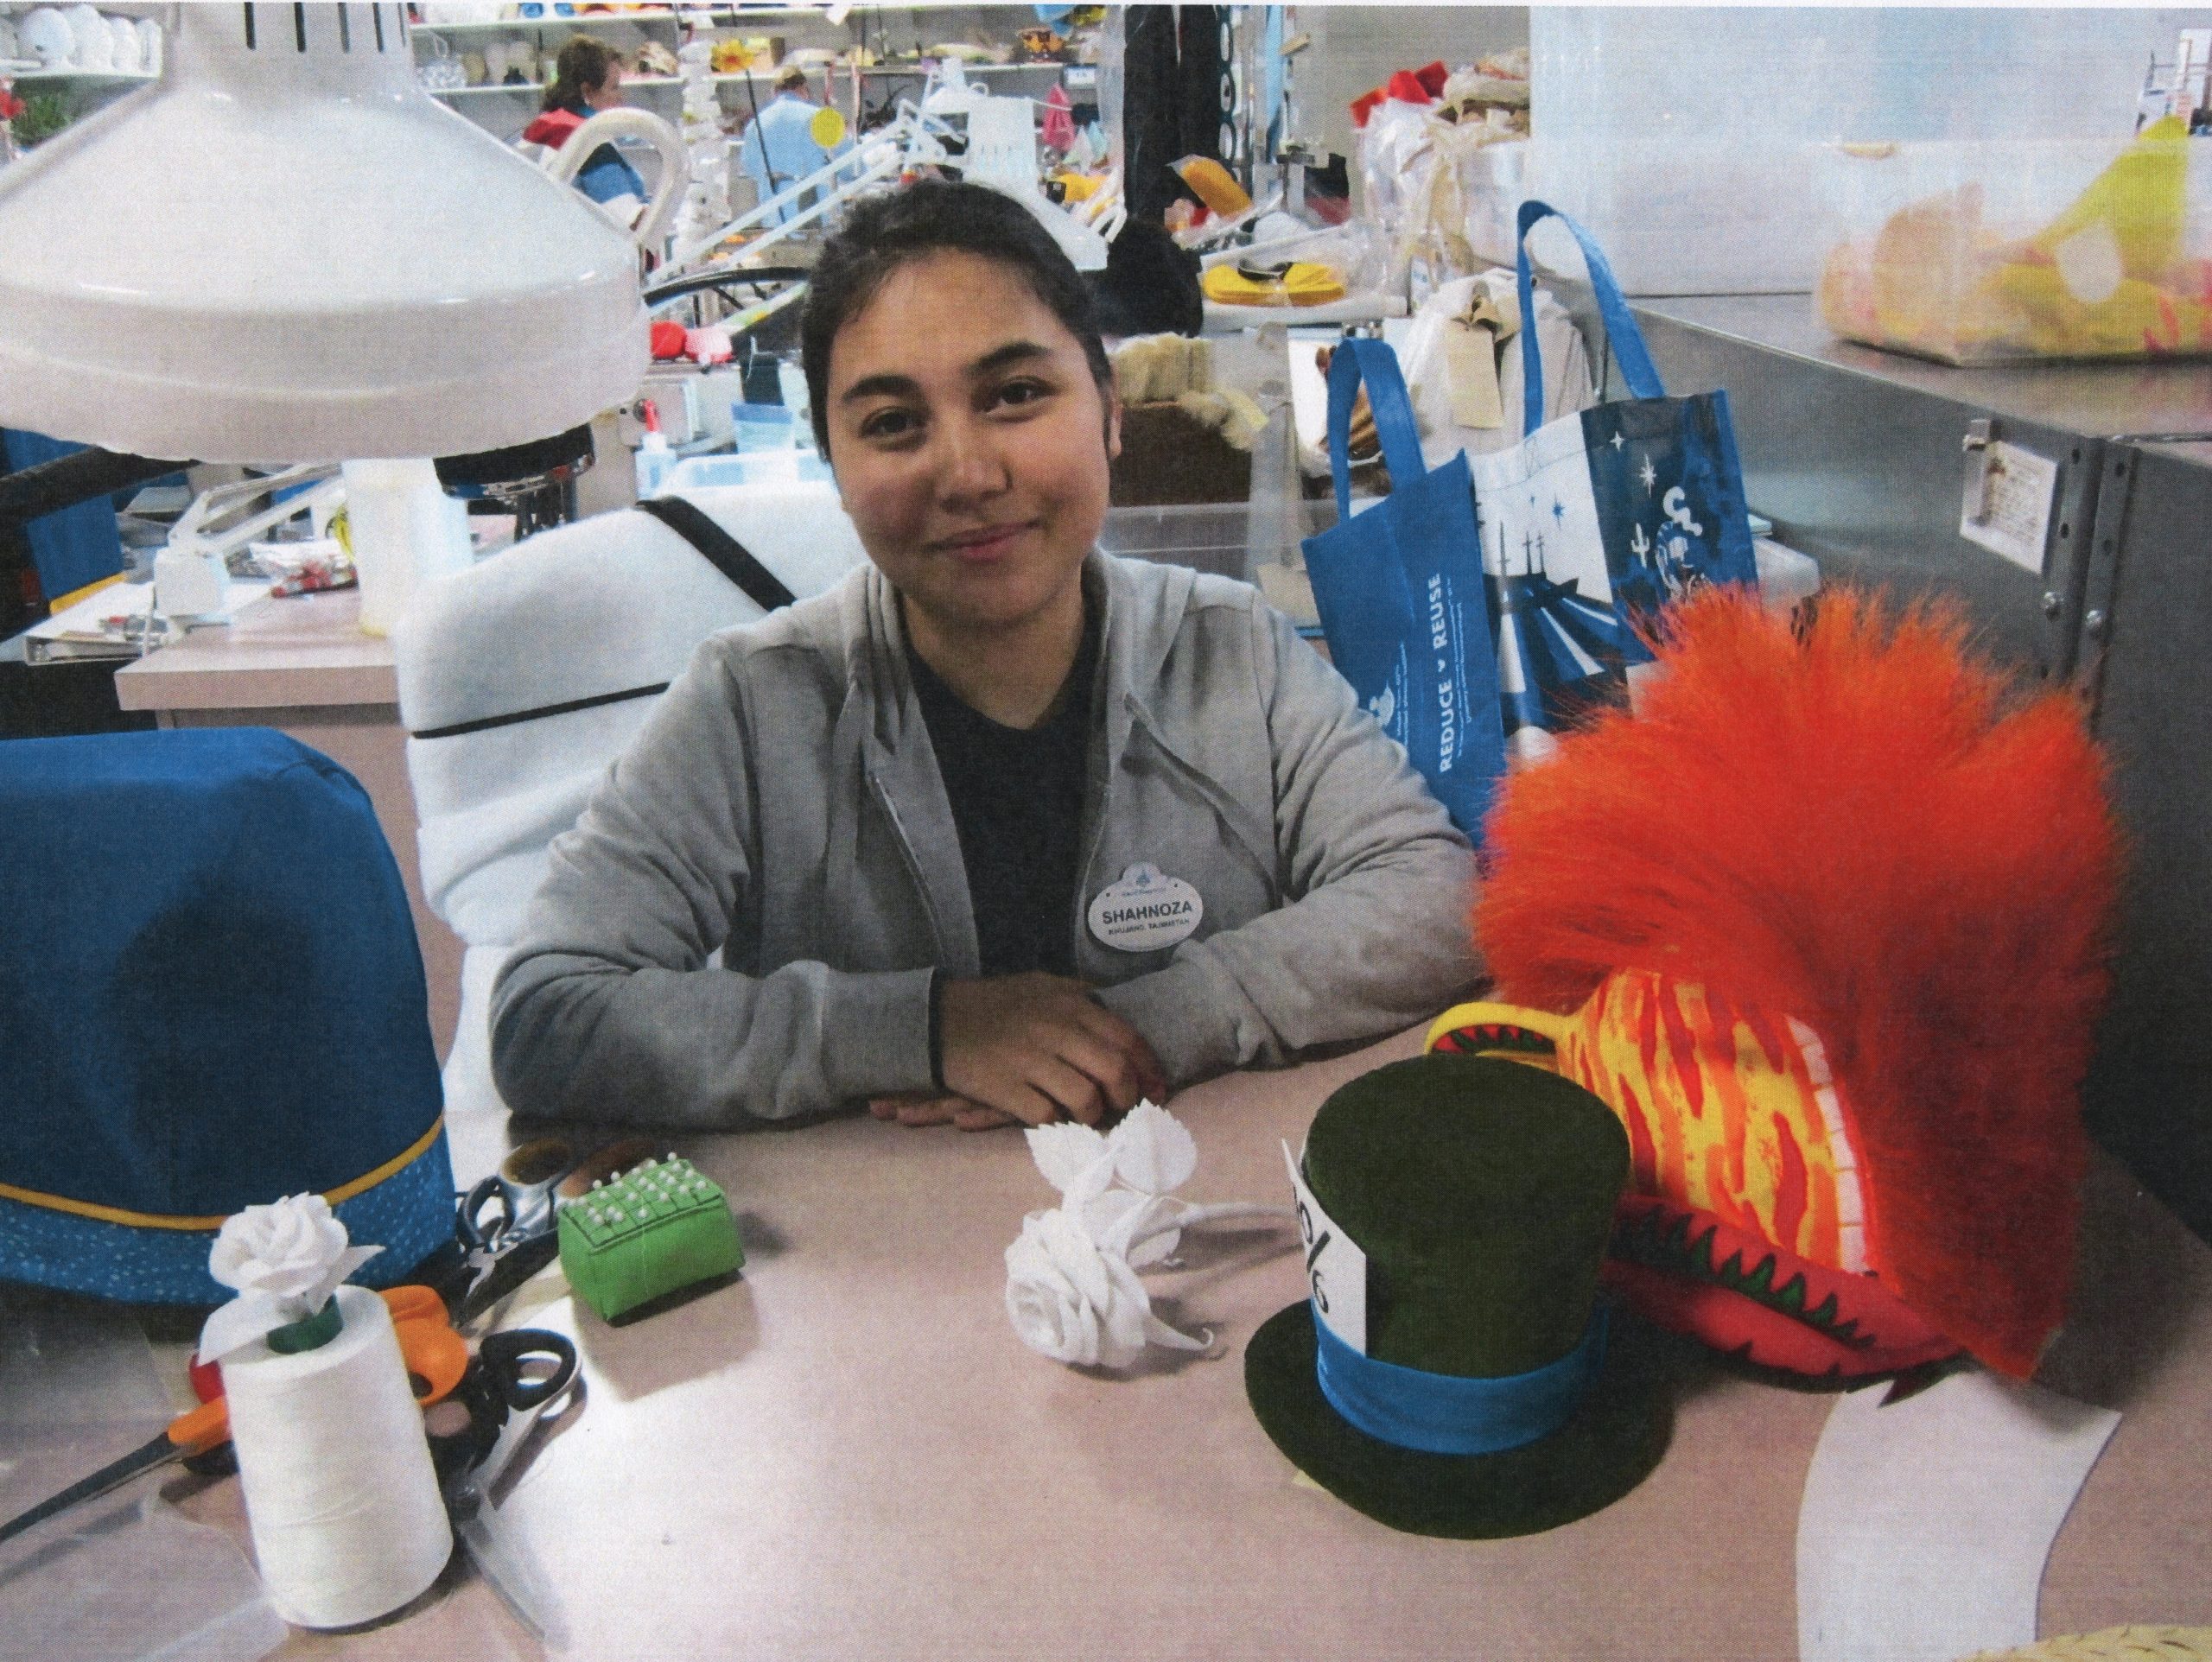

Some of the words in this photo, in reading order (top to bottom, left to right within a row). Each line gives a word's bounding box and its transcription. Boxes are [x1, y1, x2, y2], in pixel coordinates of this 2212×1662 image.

[1428, 573, 1447, 650] REUSE
[1440, 678, 1453, 773] REDUCE
[1103, 900, 1192, 924] SHAHNOZA
